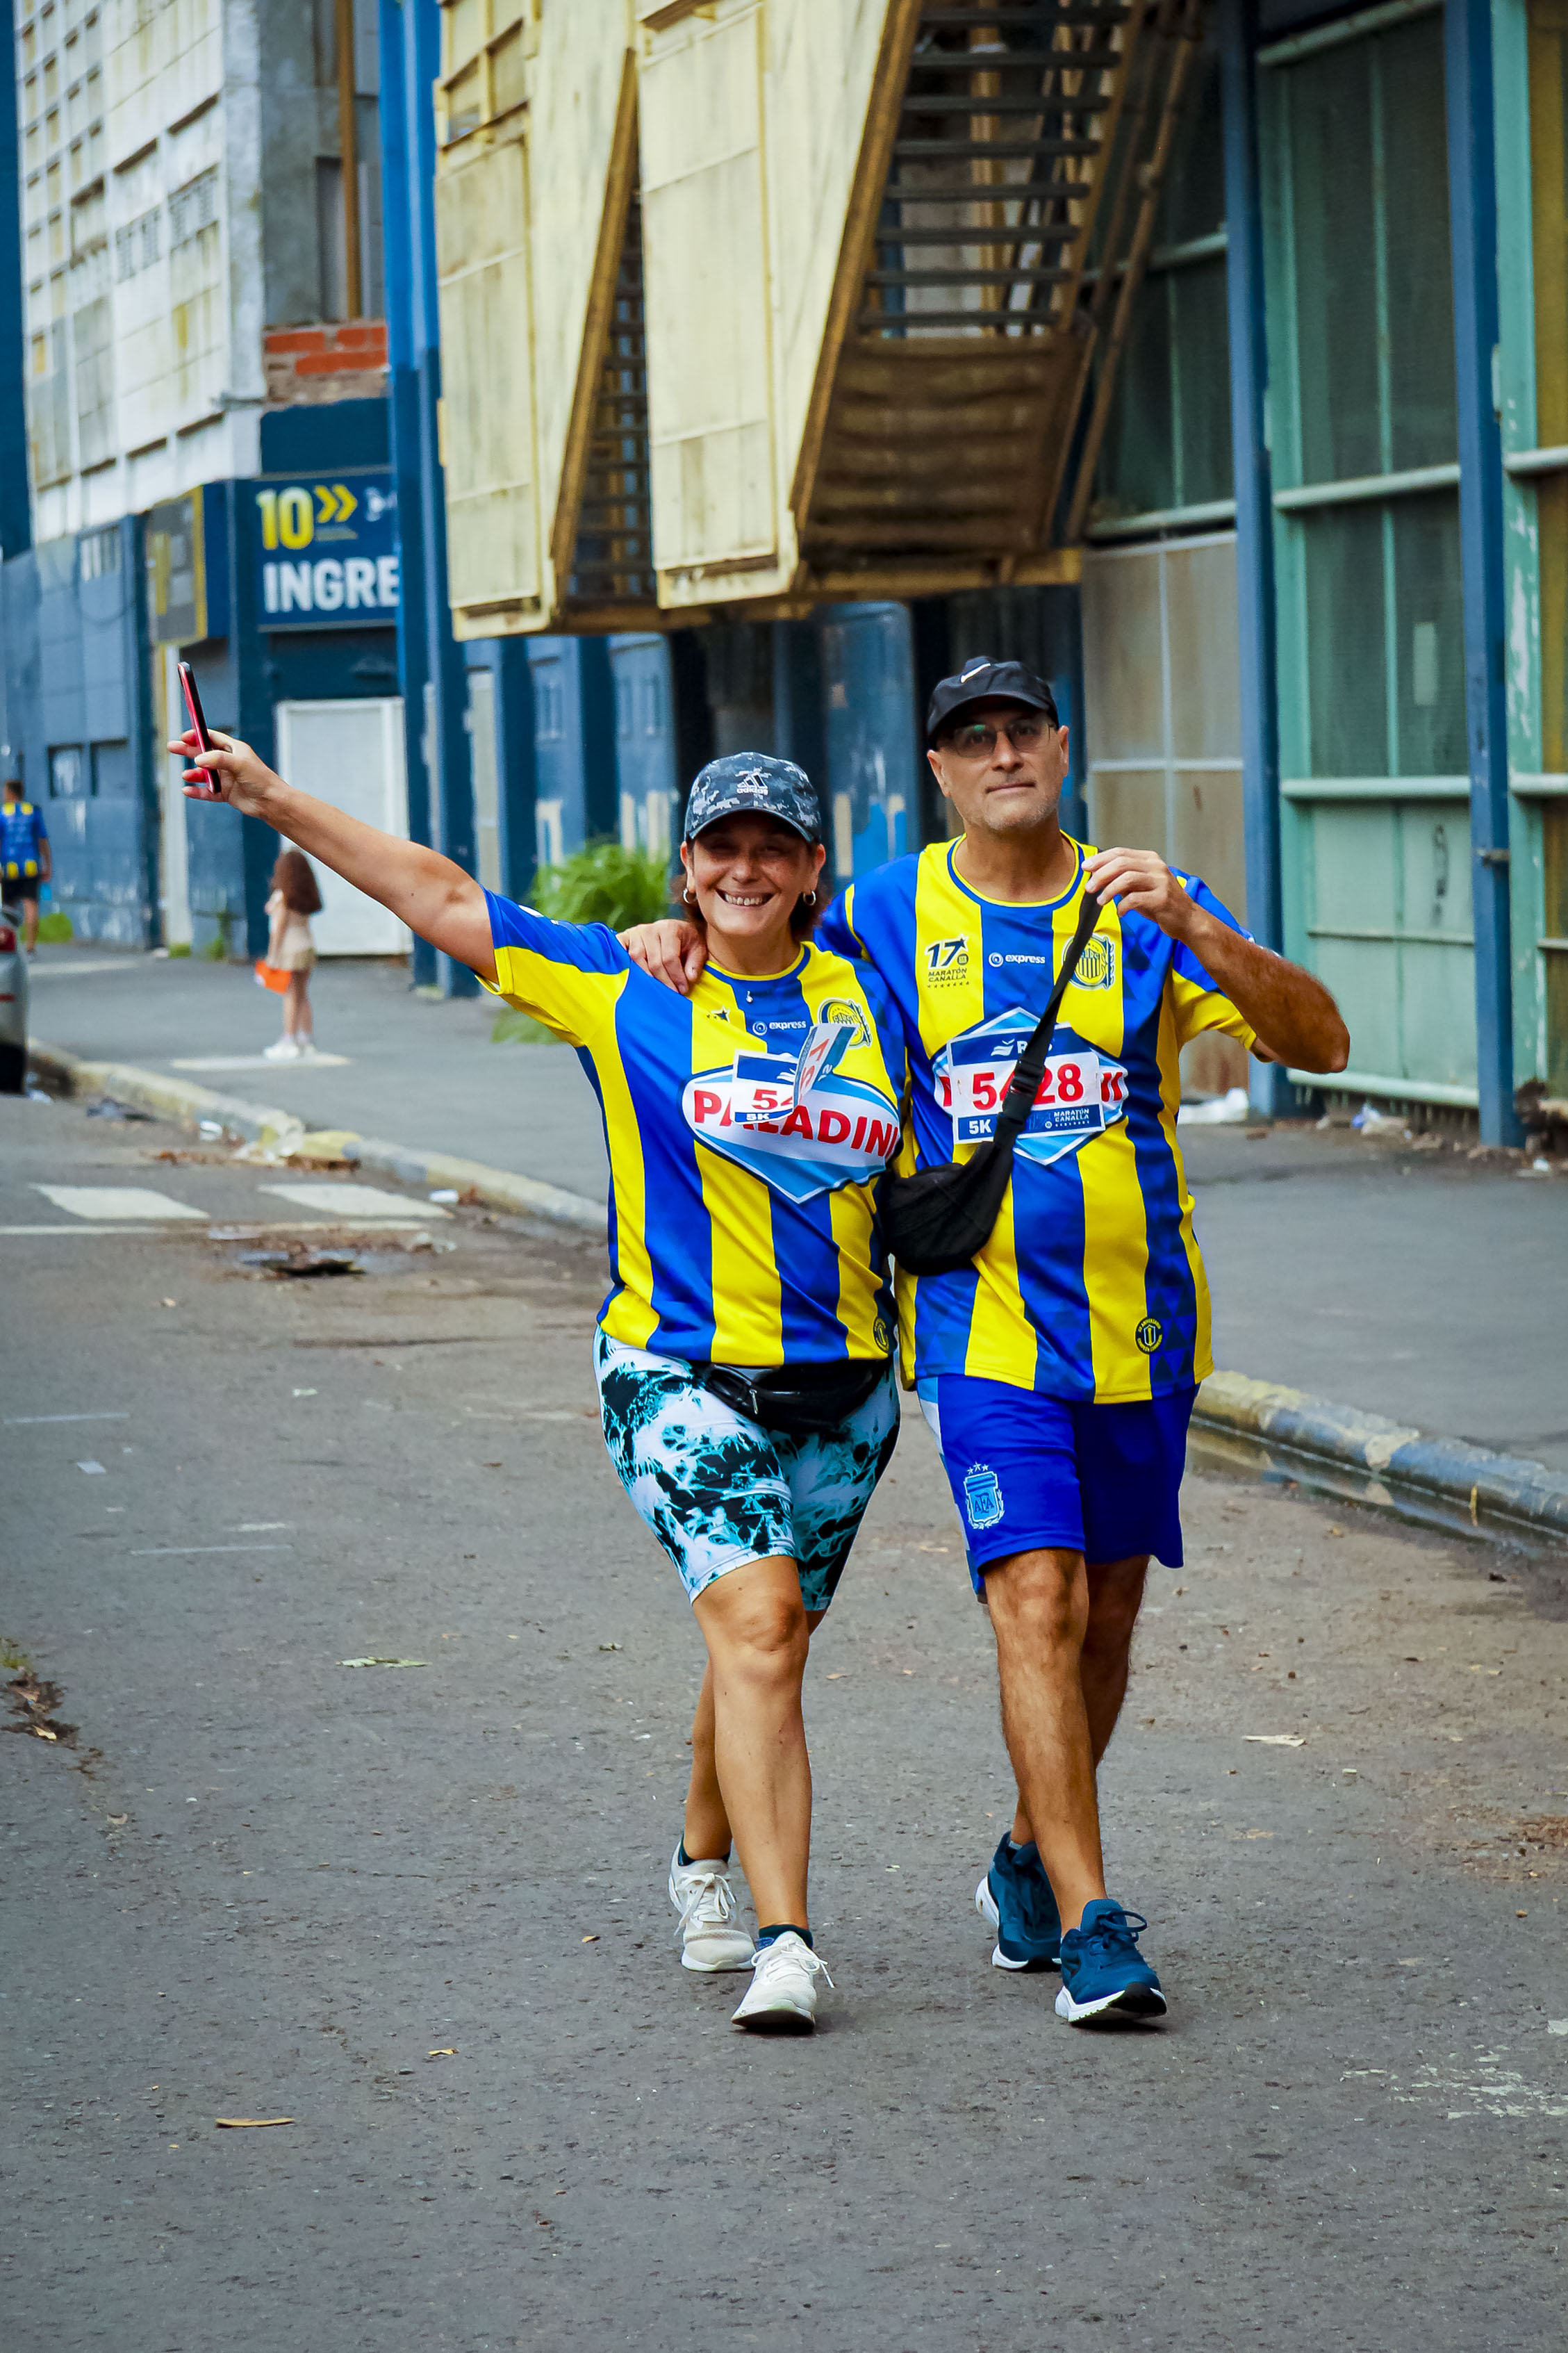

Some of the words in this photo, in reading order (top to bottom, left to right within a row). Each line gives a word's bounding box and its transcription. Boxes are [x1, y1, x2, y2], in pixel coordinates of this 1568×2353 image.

[256, 487, 313, 550] 10
[927, 937, 966, 967] 17
[1005, 954, 1046, 964] express
[928, 967, 967, 976] MARATÓN
[928, 974, 966, 983] CANALLA
[769, 1021, 807, 1030] express
[745, 1113, 770, 1121] 5K
[1055, 1114, 1089, 1122] CANALLA
[968, 1118, 992, 1135] 5K
